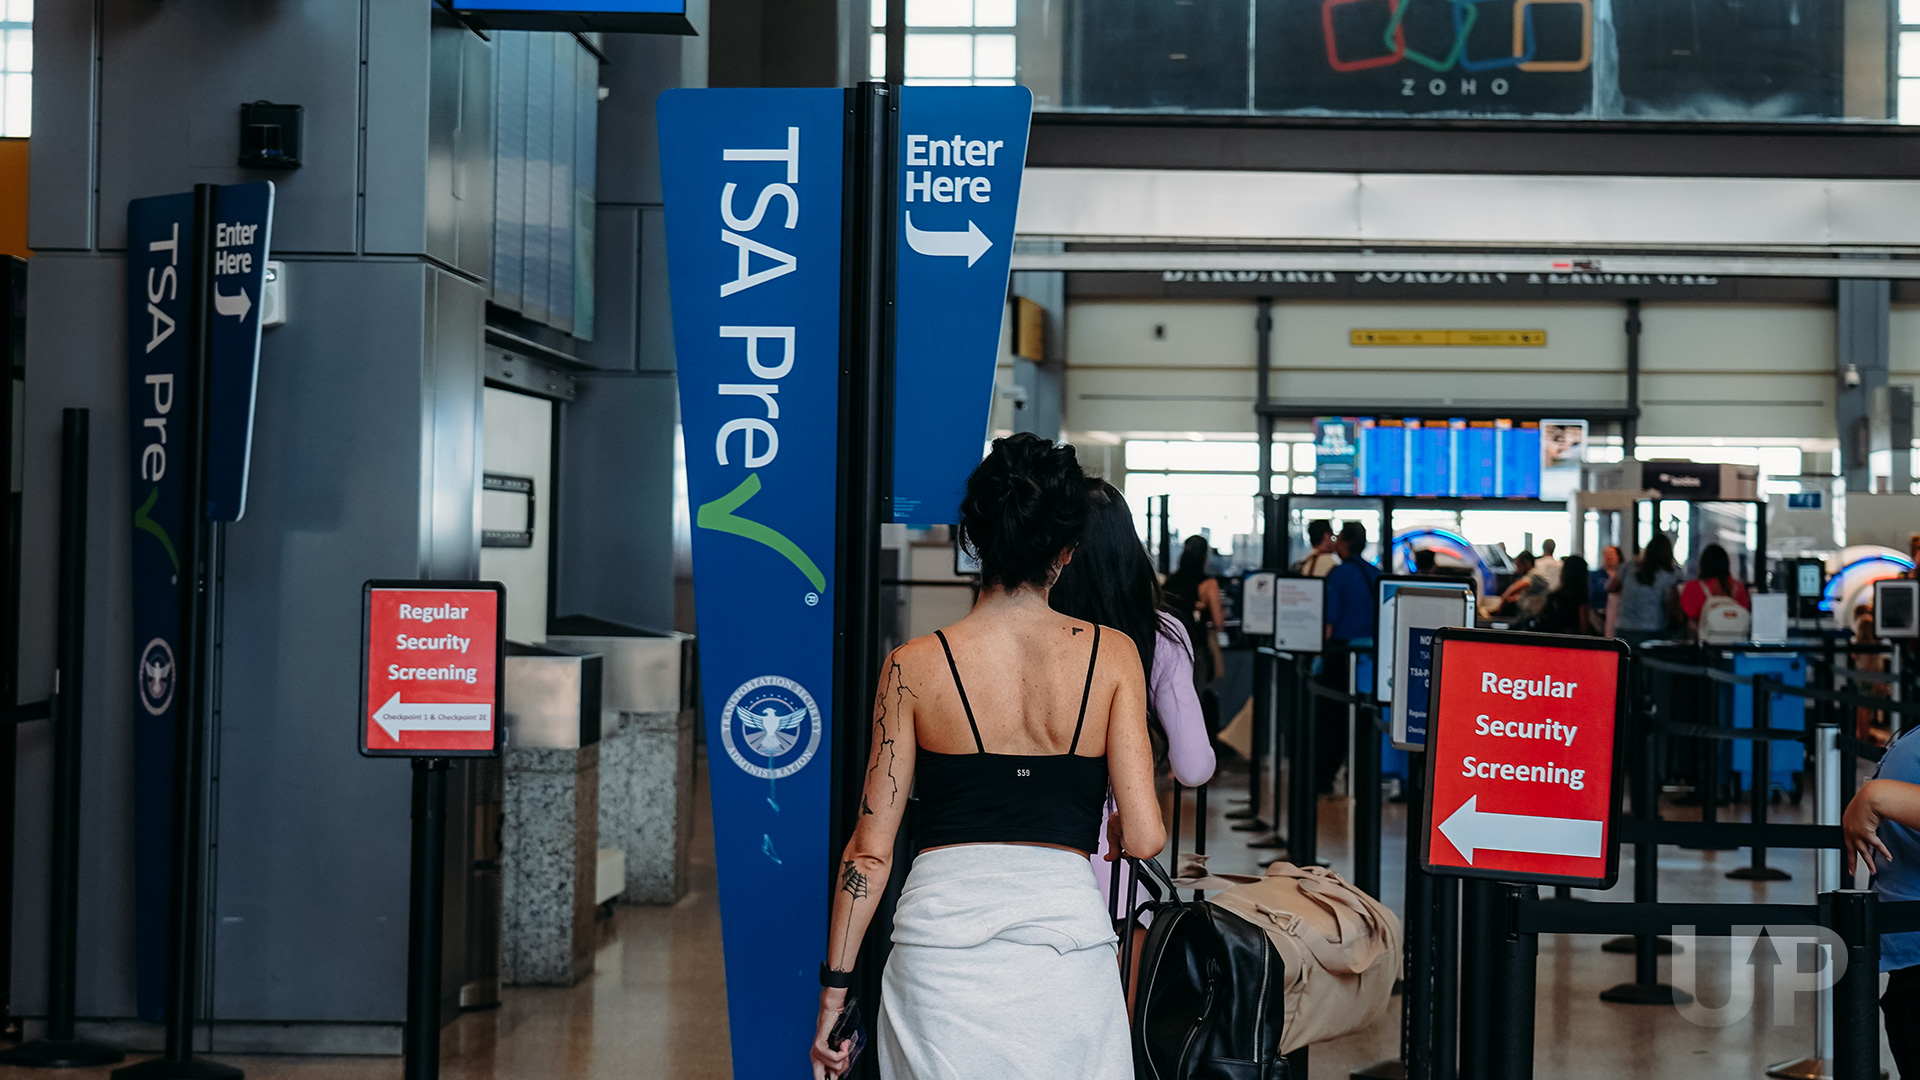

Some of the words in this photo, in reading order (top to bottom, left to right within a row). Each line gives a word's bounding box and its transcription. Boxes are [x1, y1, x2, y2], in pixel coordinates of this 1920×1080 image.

[1401, 78, 1509, 96] ZOHO
[906, 134, 1004, 167] Enter
[905, 170, 992, 204] Here
[720, 126, 800, 299] TSA
[215, 221, 258, 248] Enter
[214, 250, 252, 276] Here
[146, 221, 179, 354] TSA
[715, 325, 796, 469] Pre
[141, 373, 174, 483] Pre
[399, 602, 470, 624] Regular
[395, 633, 471, 654] Security
[387, 663, 478, 685] Screening
[1481, 671, 1578, 701] Regular
[382, 713, 422, 721] Checkpoint
[438, 713, 477, 721] Checkpoint
[722, 676, 794, 733] TRANSPORTATION
[795, 685, 821, 736] SECURITY
[1474, 713, 1578, 747] Security
[727, 746, 813, 778] ADMINISRATION
[1016, 768, 1031, 777] S59
[1461, 755, 1586, 791] Screening
